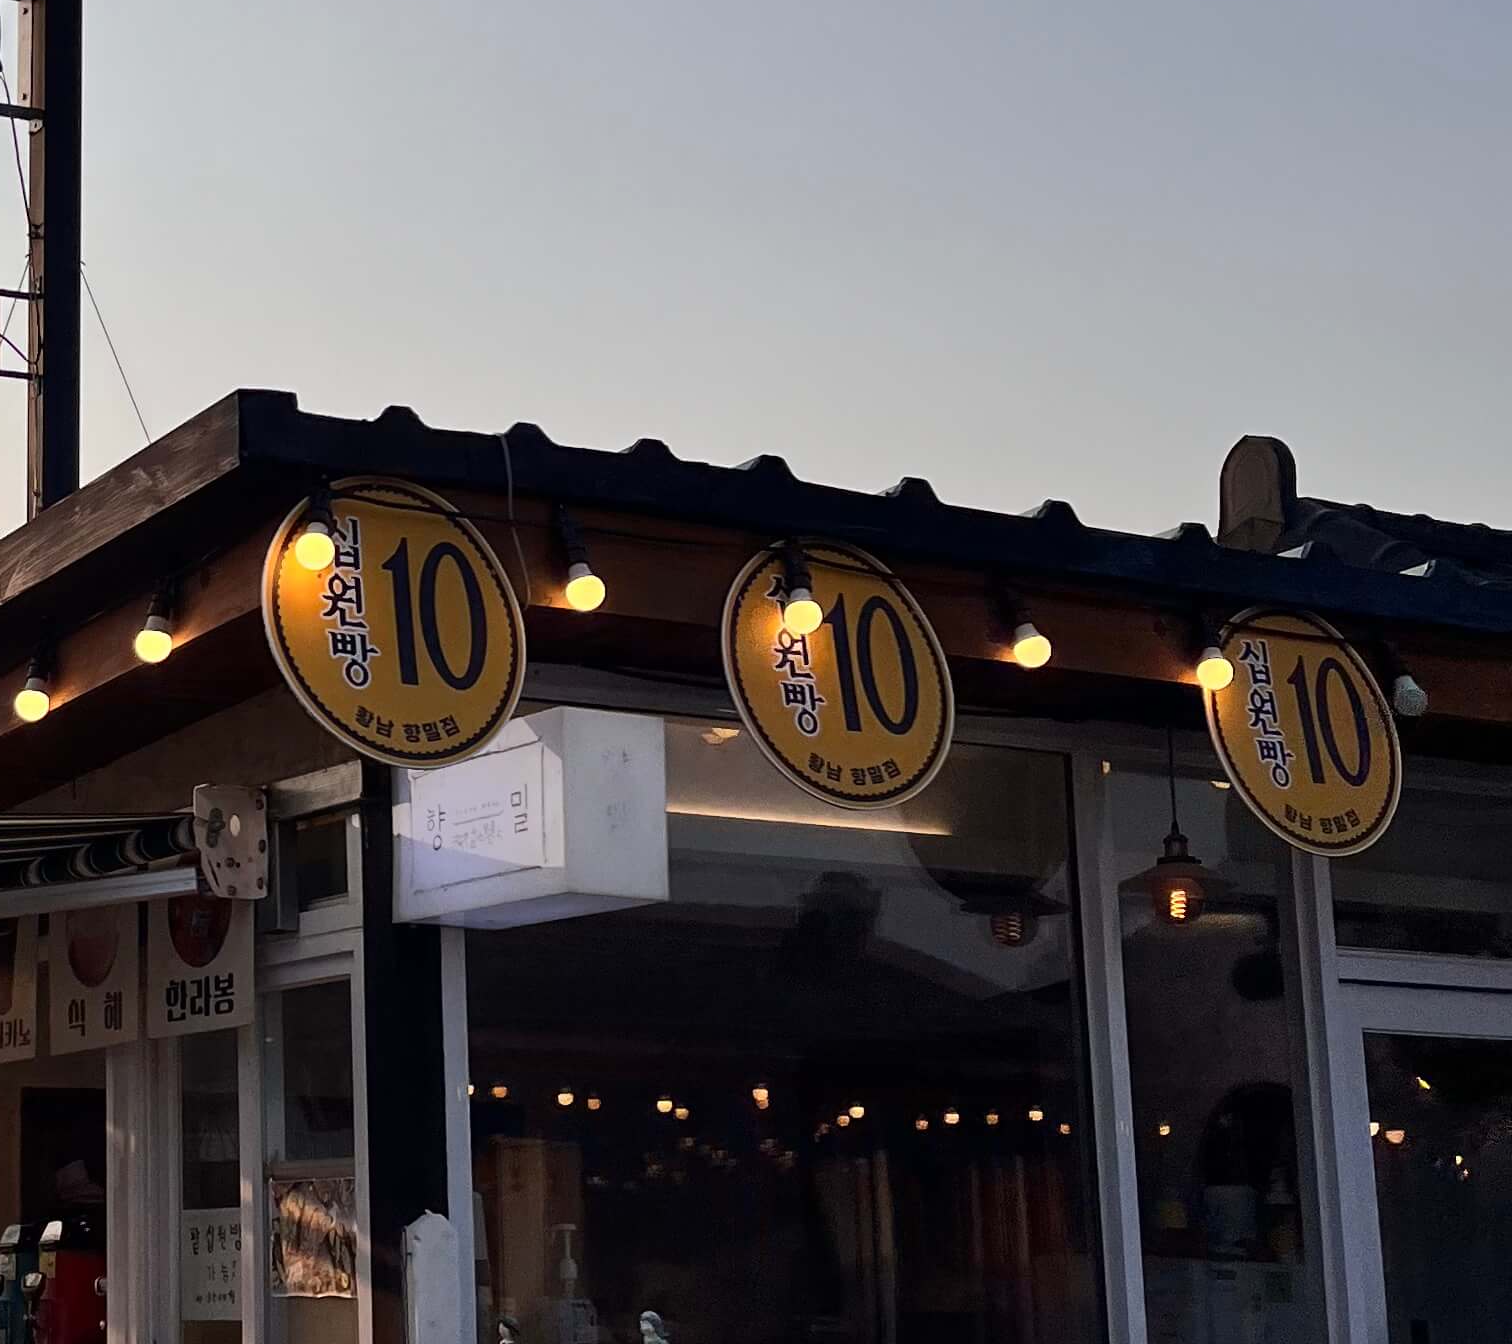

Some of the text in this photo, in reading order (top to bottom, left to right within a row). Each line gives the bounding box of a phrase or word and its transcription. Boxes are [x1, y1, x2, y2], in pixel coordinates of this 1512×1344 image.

[381, 536, 488, 691] 10
[822, 591, 919, 736] 10
[1240, 639, 1295, 790] 십원빵
[1288, 655, 1372, 788] 10
[510, 783, 529, 834] 밀
[165, 973, 235, 1023] 한라봉
